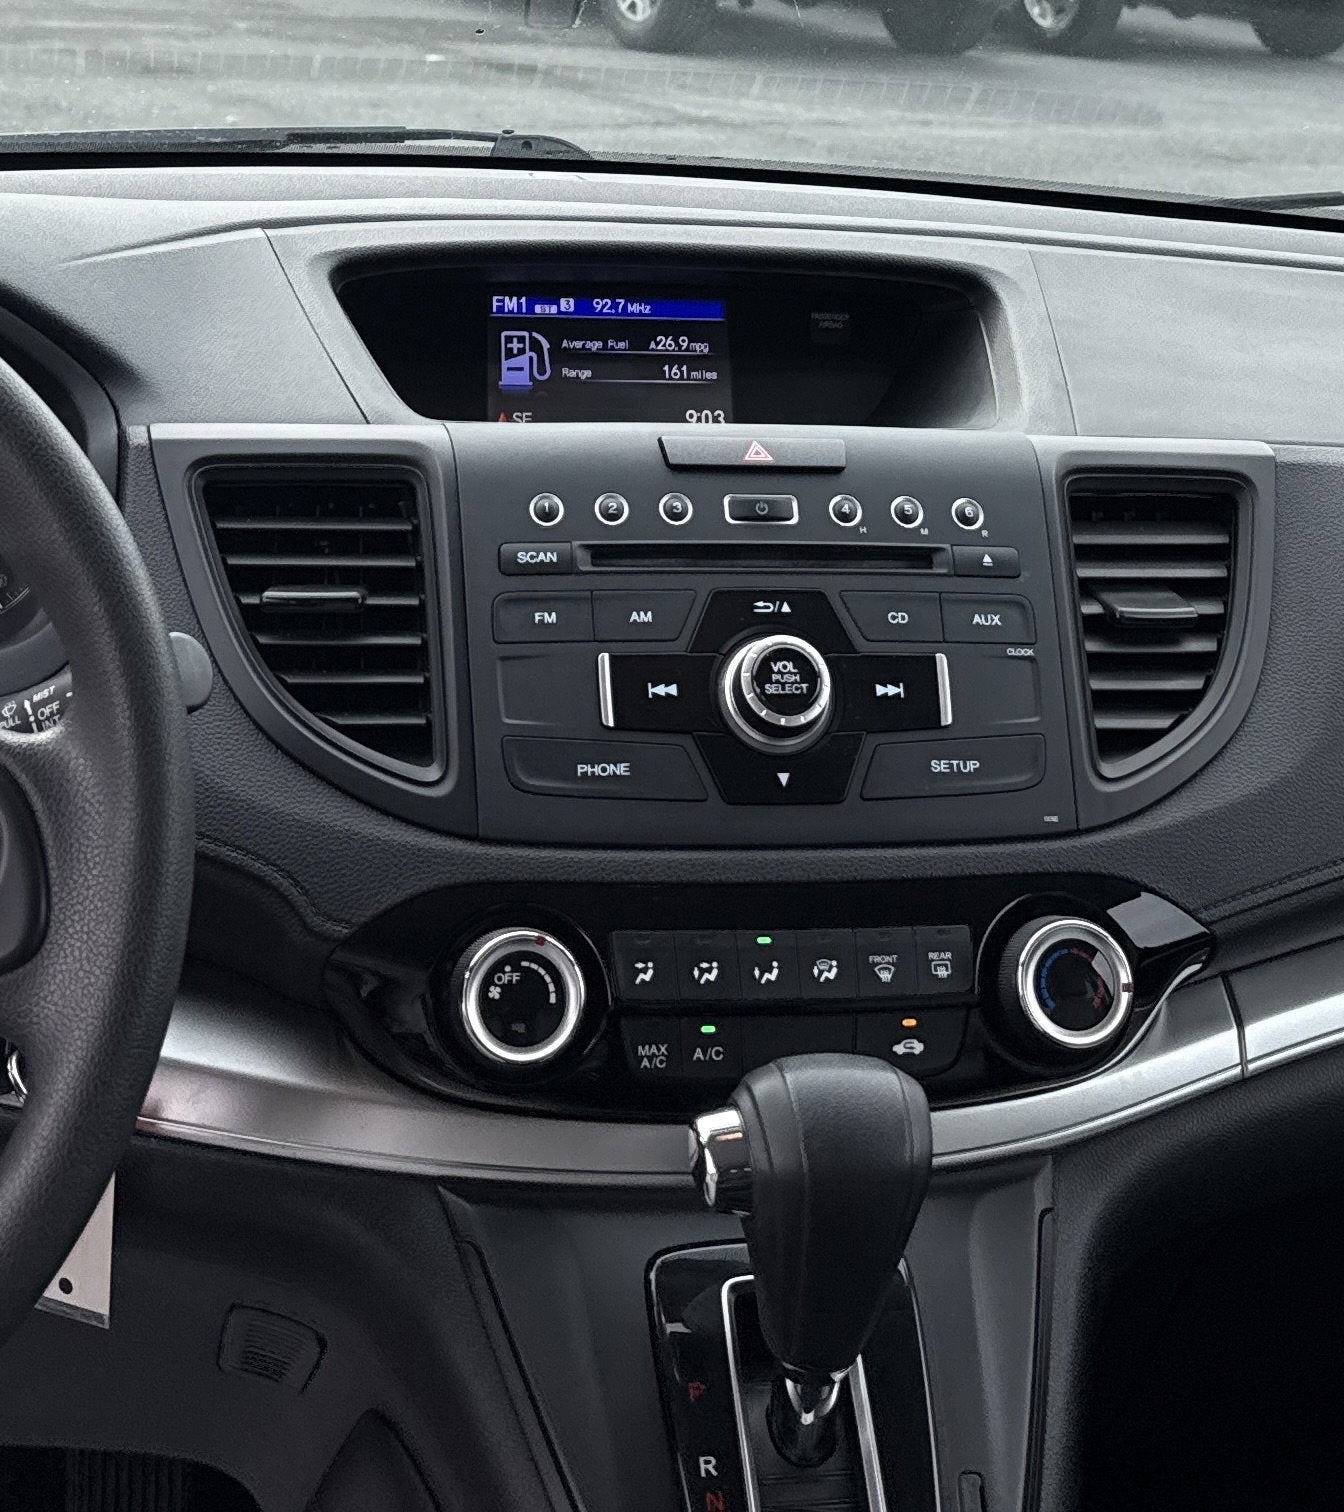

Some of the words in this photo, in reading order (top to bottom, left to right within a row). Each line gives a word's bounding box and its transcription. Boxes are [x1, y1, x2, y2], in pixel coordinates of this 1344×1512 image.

[492, 296, 527, 313] FM1
[593, 299, 625, 314] 92.7
[627, 304, 651, 314] MHz
[561, 338, 603, 351] Average
[607, 339, 628, 350] Fuel
[689, 342, 709, 354] mpg
[561, 368, 592, 380] Range
[662, 365, 688, 379] 161
[690, 369, 718, 380] miles
[685, 409, 725, 424] 9:03
[543, 502, 550, 515] 1
[607, 502, 618, 515] 2
[672, 501, 683, 514] 3
[840, 503, 850, 515] 4
[903, 504, 913, 516] 5
[965, 506, 974, 518] 6
[859, 526, 867, 534] H
[517, 550, 557, 564] SCAN
[534, 611, 557, 624] FM
[629, 610, 653, 623] AM
[887, 611, 908, 624] CD
[972, 613, 1002, 626] AUX
[1006, 647, 1035, 656] CLOCK
[770, 661, 799, 674] VOL
[771, 674, 801, 683] PUSH
[32, 684, 56, 703] MIST
[764, 683, 808, 695] SELECT
[37, 700, 60, 720] OFF
[576, 763, 631, 776] PHONE
[930, 759, 980, 773] SETUP
[868, 954, 897, 964] FRONT
[928, 951, 952, 960] REAR
[493, 972, 521, 985] OFF
[637, 1044, 668, 1056] MAX
[692, 1046, 724, 1061] A/C
[640, 1056, 667, 1069] A/C
[688, 1382, 705, 1403] P
[698, 1455, 718, 1479] R
